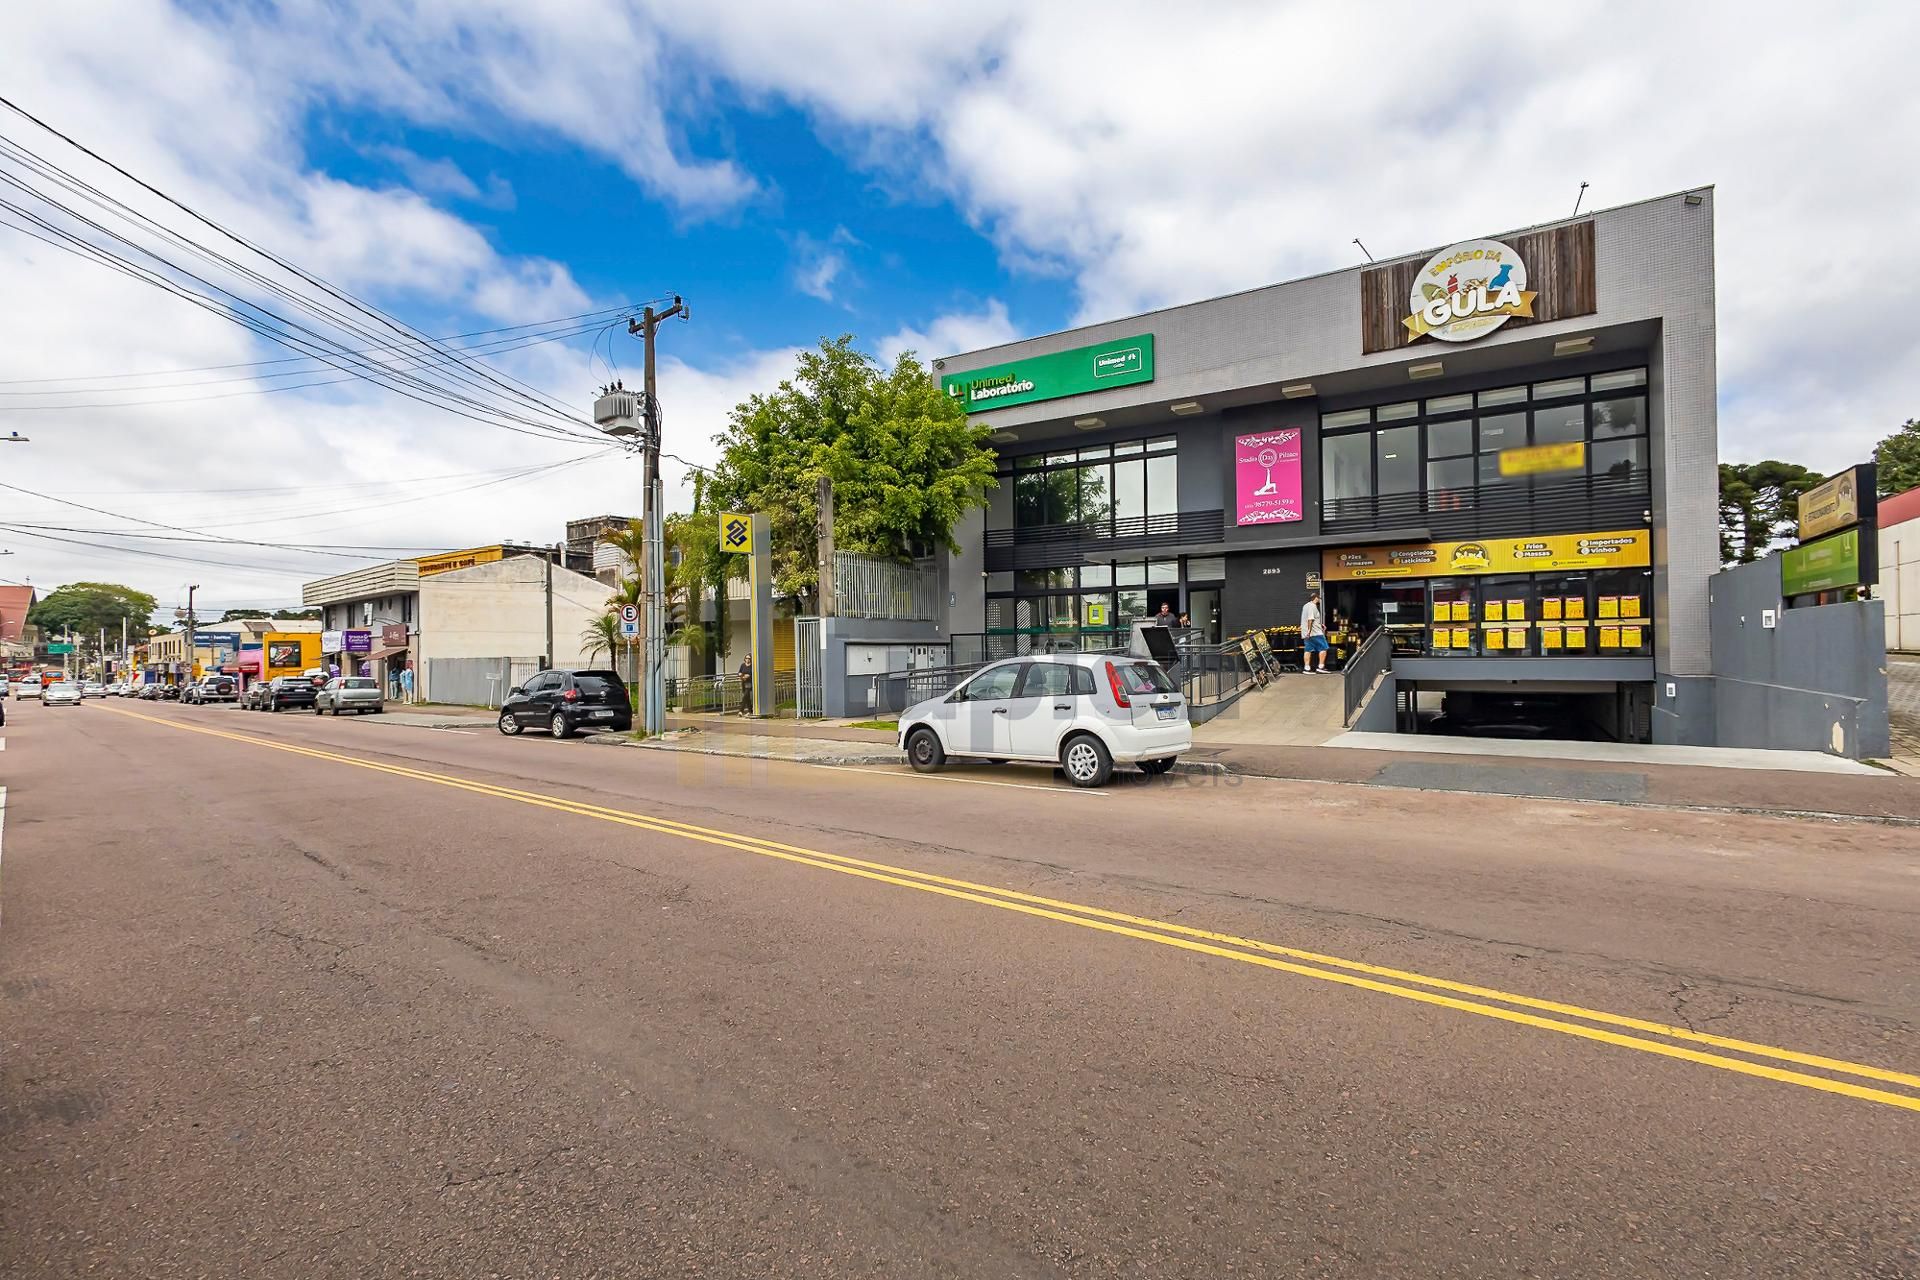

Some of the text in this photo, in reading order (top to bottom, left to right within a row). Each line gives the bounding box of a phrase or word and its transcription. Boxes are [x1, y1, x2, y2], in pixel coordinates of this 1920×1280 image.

[1428, 249, 1503, 277] EMPÓRIO DA
[1422, 279, 1522, 326] GULA
[971, 372, 1016, 389] Unimed
[970, 380, 1034, 400] Laboratório
[1589, 537, 1633, 547] Importados
[1524, 550, 1551, 558] Massas
[1590, 546, 1617, 554] Vinhos
[625, 607, 633, 618] E
